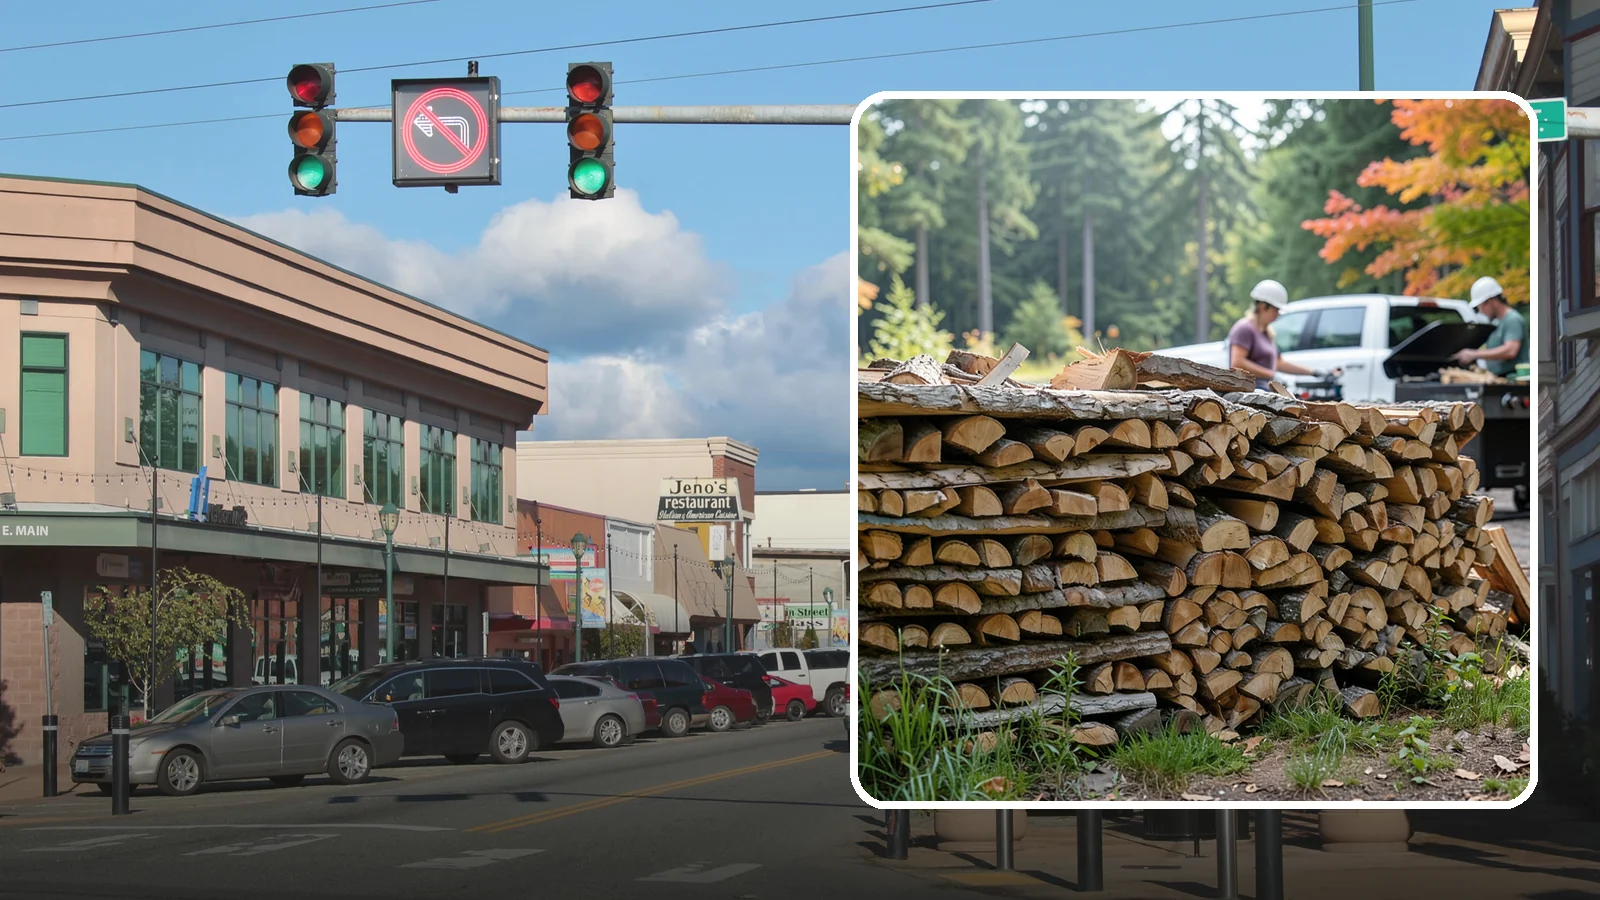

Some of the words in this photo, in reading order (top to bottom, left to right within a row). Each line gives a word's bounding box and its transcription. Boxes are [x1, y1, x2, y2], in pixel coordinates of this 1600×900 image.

[670, 480, 728, 494] Jeno's
[665, 496, 730, 508] restaurant
[658, 510, 681, 519] Italian
[686, 510, 714, 519] American
[715, 510, 737, 519] Cuisine
[2, 525, 13, 536] E.
[16, 525, 48, 536] MAIN
[798, 608, 828, 616] Street
